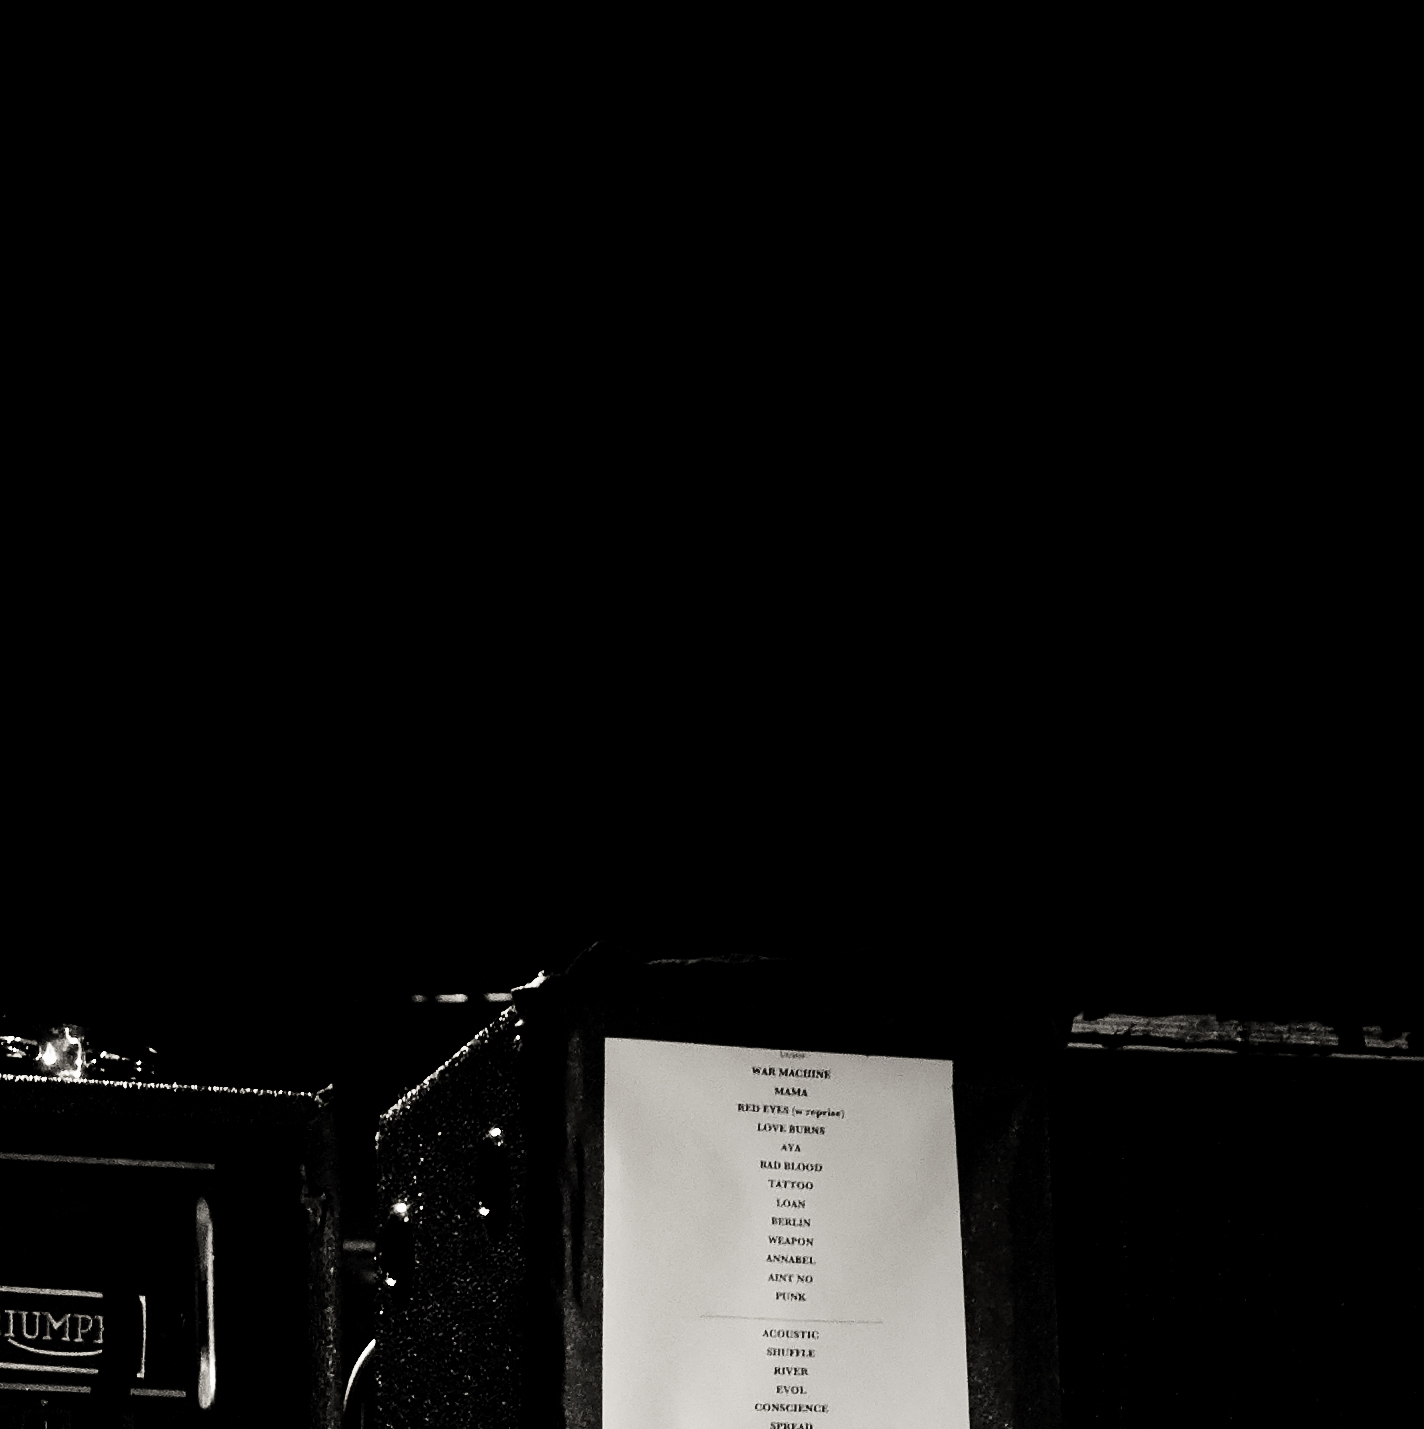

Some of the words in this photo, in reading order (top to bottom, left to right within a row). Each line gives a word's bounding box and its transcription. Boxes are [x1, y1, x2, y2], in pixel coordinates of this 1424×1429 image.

[751, 1066, 777, 1077] WAR
[778, 1067, 831, 1080] MACHINE
[774, 1086, 808, 1098] MAMA
[737, 1103, 761, 1113] RED
[762, 1104, 790, 1115] EYES
[756, 1122, 787, 1133] LOVE
[788, 1124, 826, 1136] BURNS
[780, 1142, 801, 1153] AYA
[783, 1161, 823, 1173] BLOOD
[767, 1179, 814, 1190] TATTOO
[776, 1198, 806, 1209] LOAN
[771, 1216, 811, 1228] BERLIN
[768, 1235, 814, 1247] WEAPON
[765, 1254, 817, 1266] ANNABEL
[796, 1274, 814, 1284] NO
[775, 1291, 807, 1302] PUNK
[762, 1329, 820, 1341] ACOUSTIC
[766, 1347, 816, 1358] SHUFFLE
[773, 1366, 809, 1376] RIVER
[776, 1385, 808, 1395] EVOL
[754, 1402, 830, 1414] CONSCIENCE
